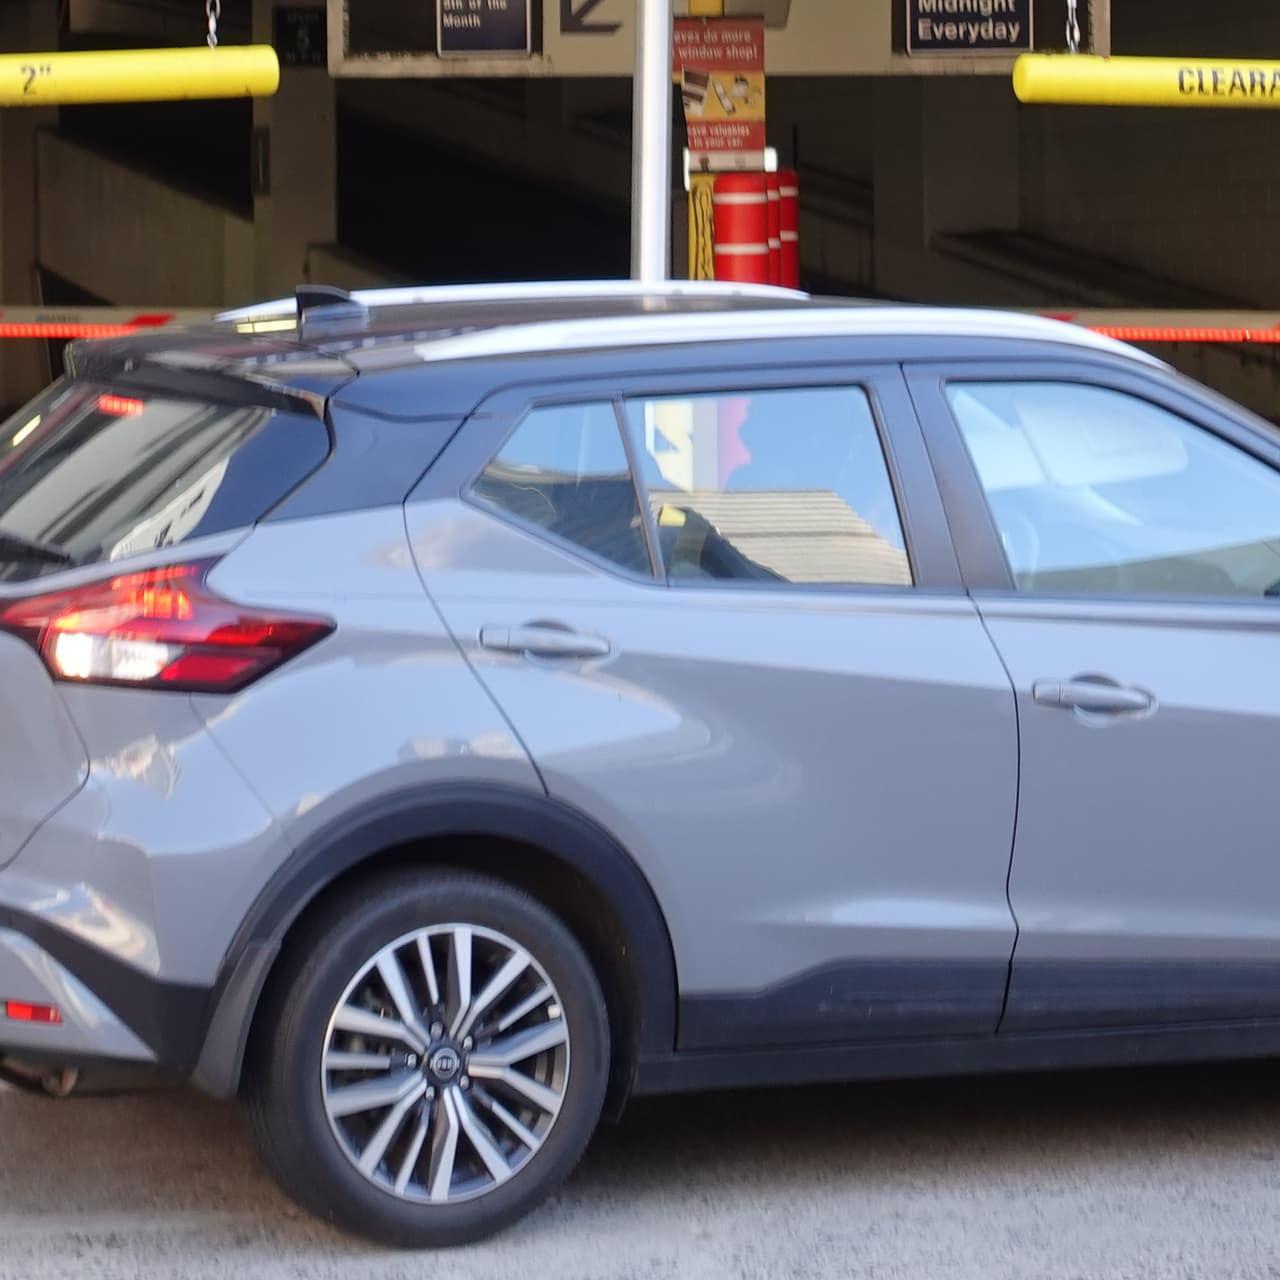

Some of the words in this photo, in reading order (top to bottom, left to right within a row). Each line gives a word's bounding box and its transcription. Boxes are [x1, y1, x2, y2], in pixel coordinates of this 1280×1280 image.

[442, 13, 481, 28] Month
[721, 30, 752, 43] more
[918, 18, 1020, 44] Everyday
[678, 45, 722, 60] window
